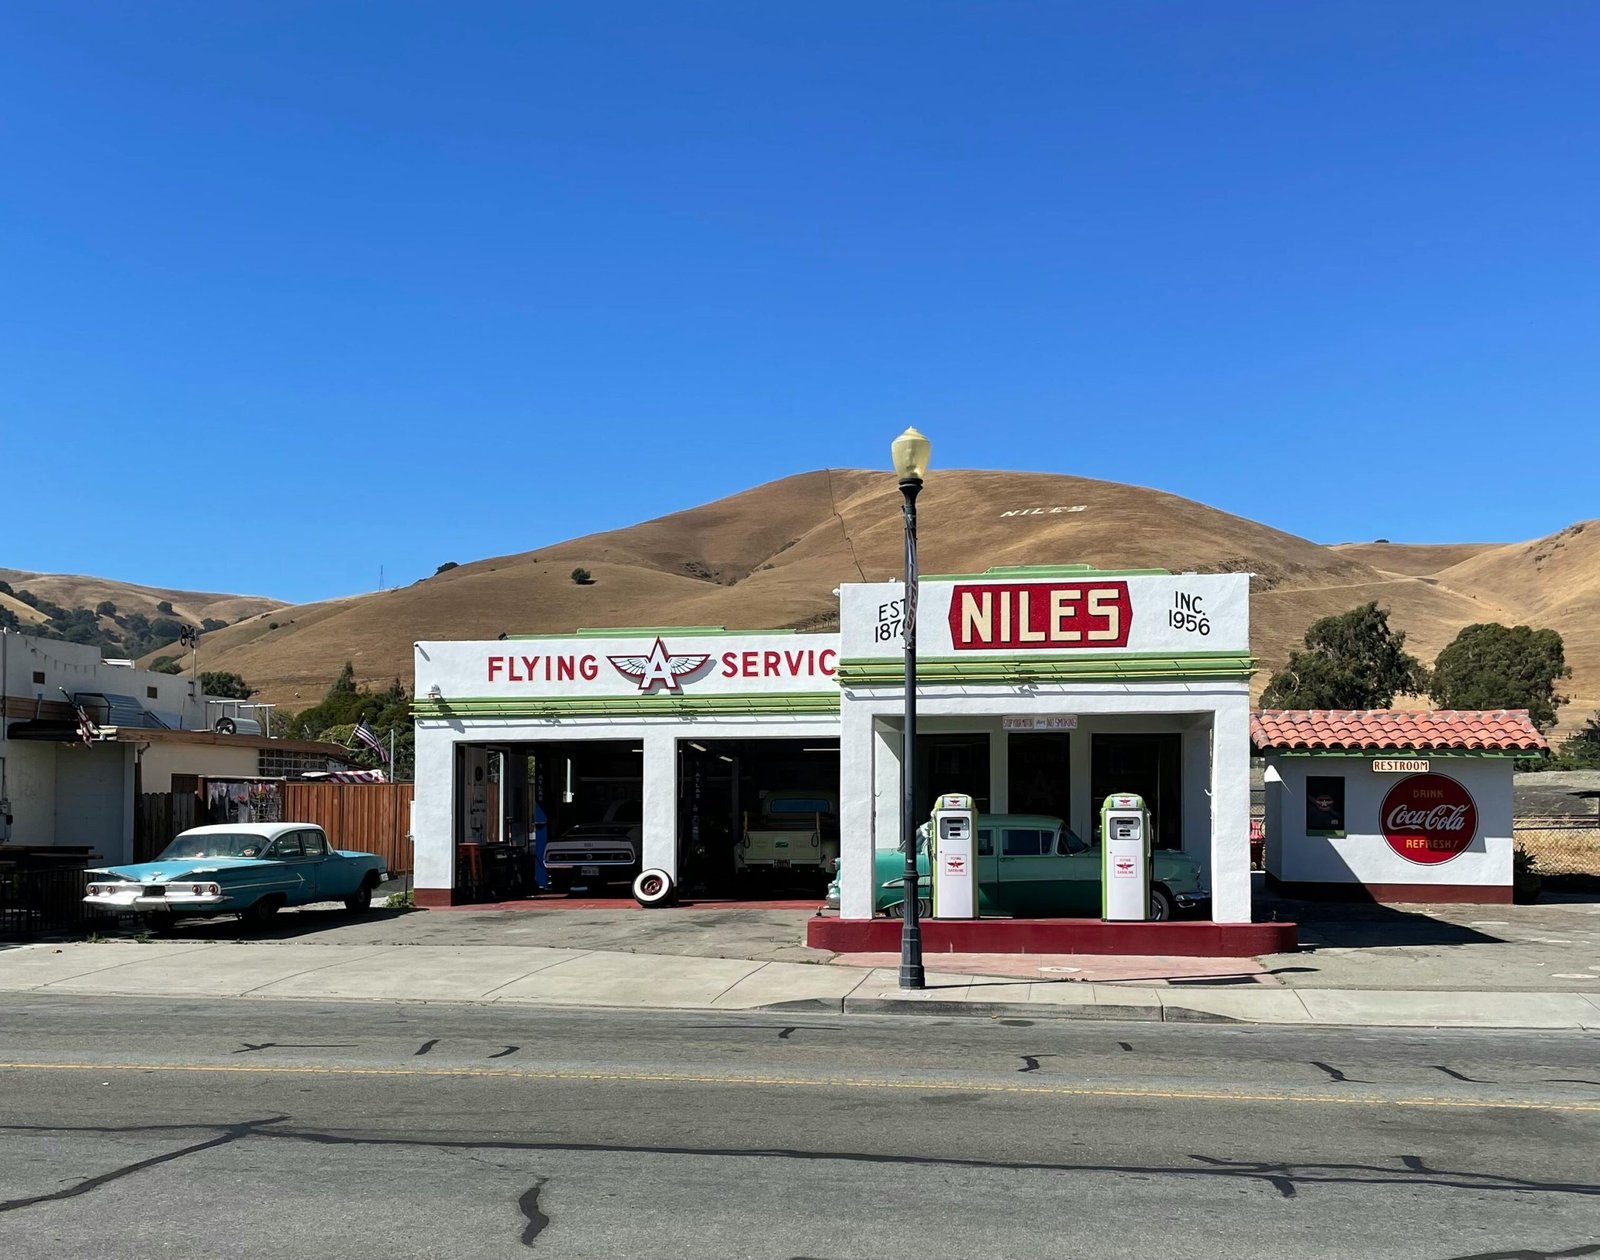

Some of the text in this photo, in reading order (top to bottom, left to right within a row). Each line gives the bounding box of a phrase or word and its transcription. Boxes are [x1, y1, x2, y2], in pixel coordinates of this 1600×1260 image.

[999, 505, 1088, 518] NILES
[961, 588, 1121, 643] NILES
[1175, 591, 1206, 616] INC.
[1169, 609, 1210, 636] 1956
[489, 655, 598, 681] FLYING
[638, 635, 679, 690] A
[1374, 761, 1428, 771] RESTROOM
[1413, 789, 1444, 798] DRINK
[1387, 804, 1470, 831] Coca-Cola
